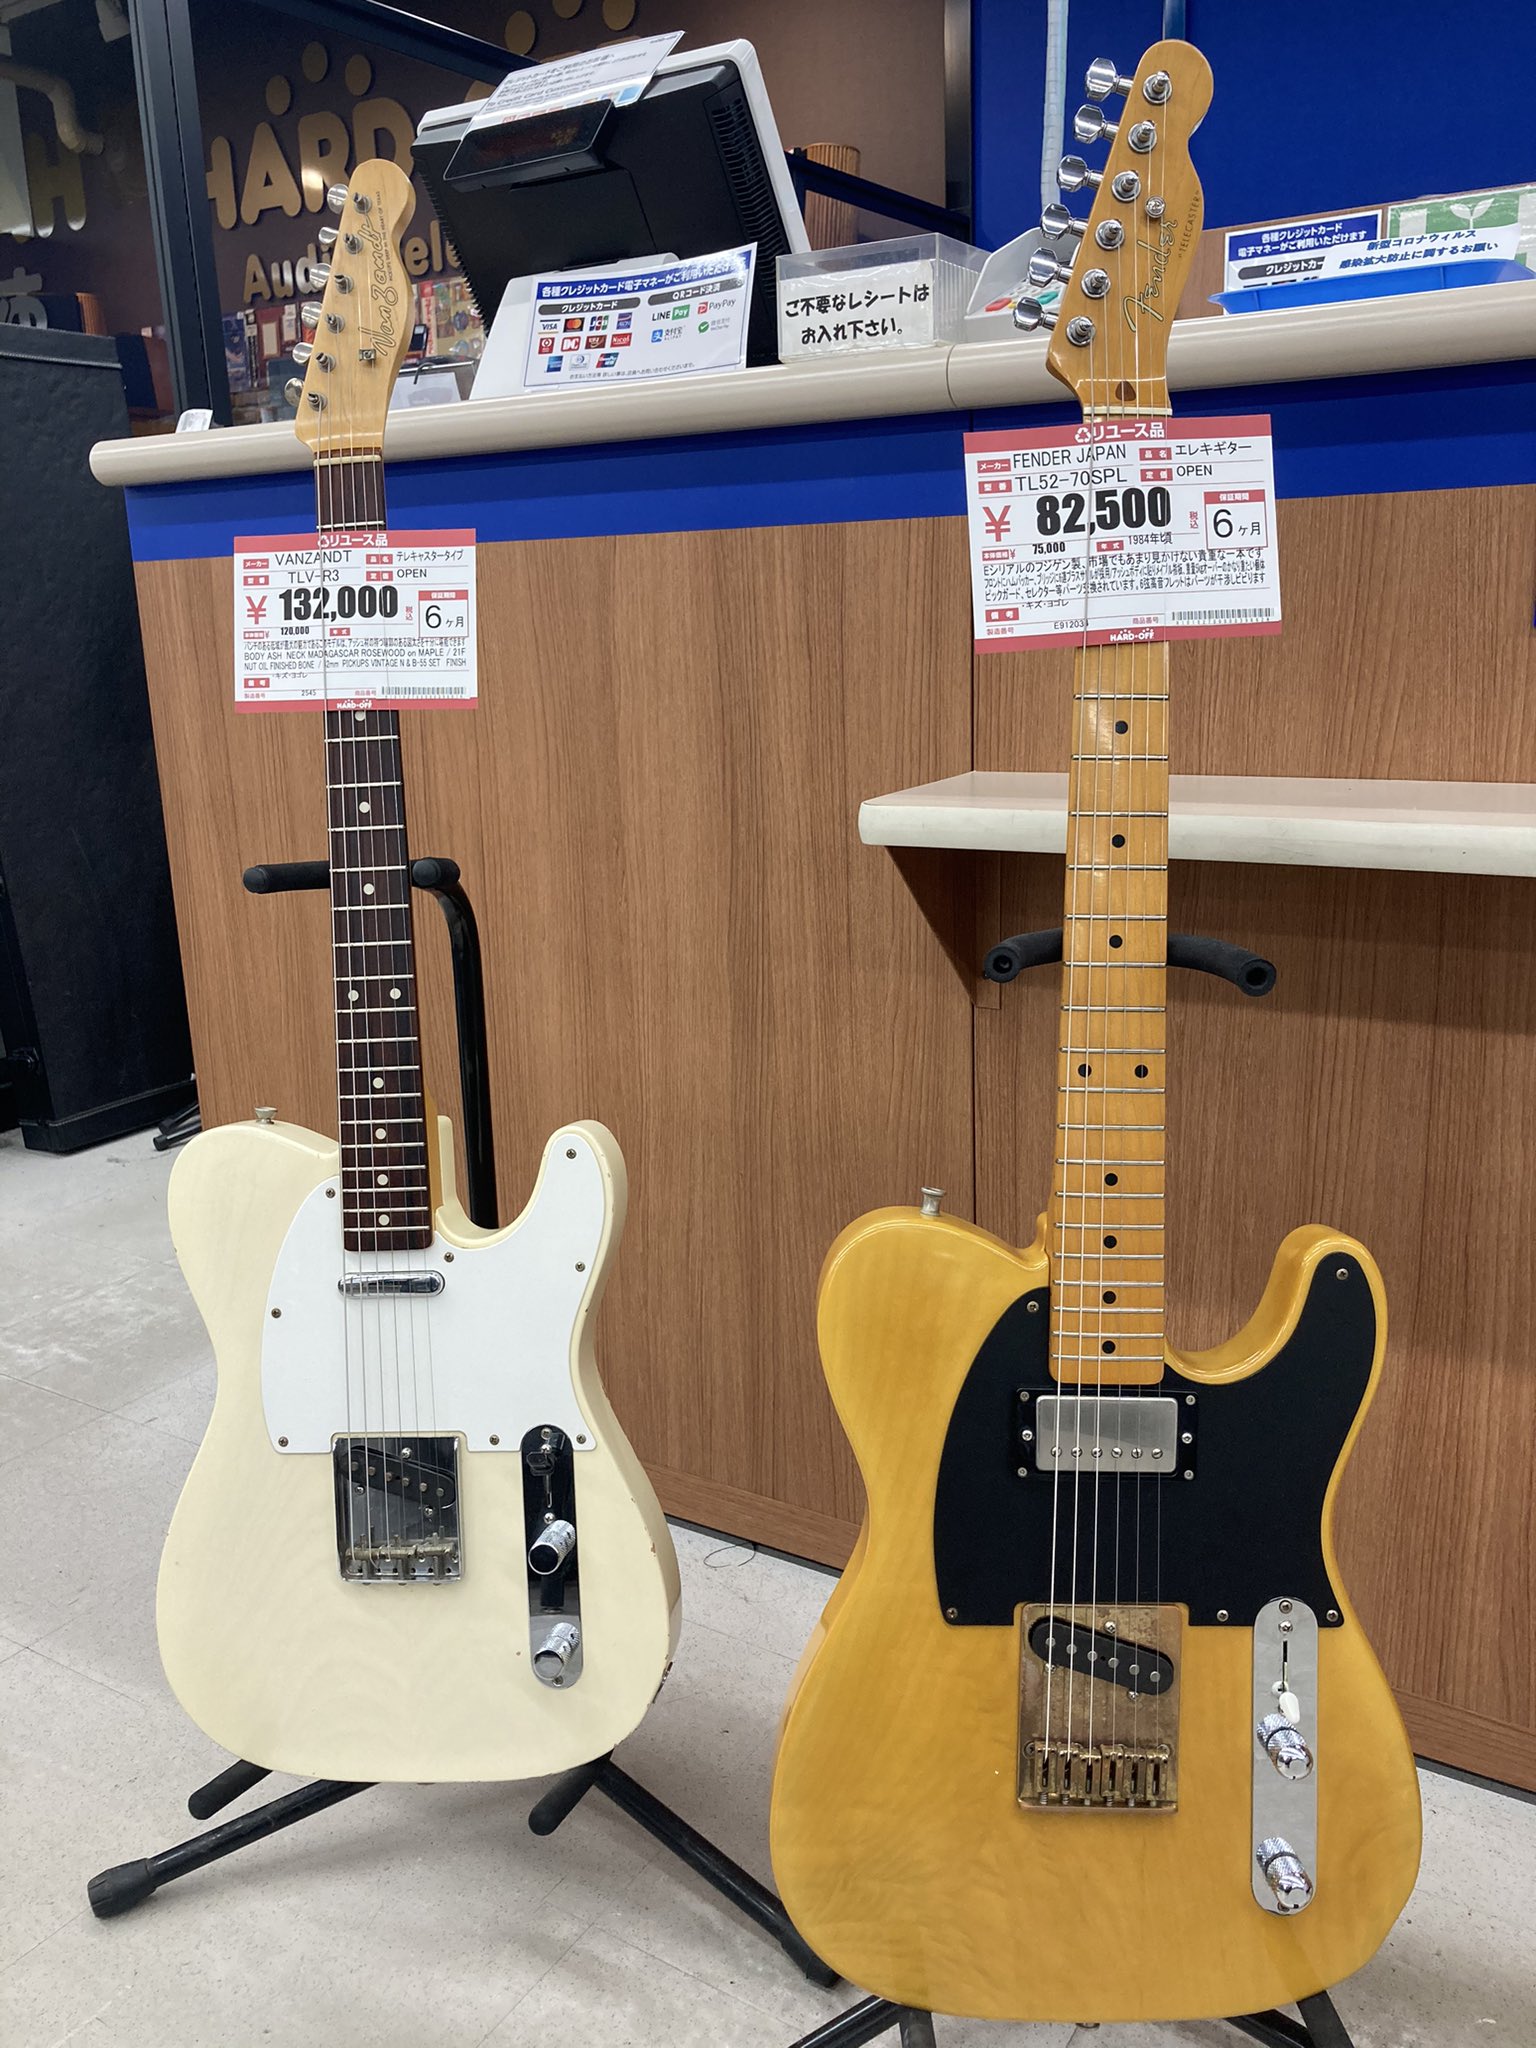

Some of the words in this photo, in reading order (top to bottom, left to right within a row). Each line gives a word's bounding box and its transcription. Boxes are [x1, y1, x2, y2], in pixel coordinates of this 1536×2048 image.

[1367, 230, 1477, 251] 新型コロナウィルス
[1339, 242, 1498, 269] 感染拡大防止に関するお願い
[1122, 219, 1178, 334] Fender
[561, 301, 618, 313] クレジットカード
[709, 299, 736, 310] PayPay
[785, 284, 930, 318] ご不要なレシートは
[652, 311, 671, 321] LINE
[542, 323, 558, 331] VISA
[801, 318, 903, 345] お入れ下さい。
[562, 338, 579, 350] DC
[1094, 422, 1164, 440] リユース品
[1175, 442, 1252, 455] エレキギター
[1013, 449, 1071, 468] FENDER
[1077, 444, 1126, 463] JAPAN
[980, 462, 1008, 470] メーカー
[1176, 465, 1212, 476] OPEN
[1015, 468, 1127, 491] TL52-70SPL
[1036, 486, 1171, 536] 82,500
[330, 533, 388, 547] リユース品
[1128, 531, 1173, 545] 1984年頃
[396, 549, 463, 561] テレキャスタータイプ
[1032, 542, 1065, 555] 75,000
[275, 550, 352, 566] VANZANDT
[288, 569, 340, 584] TLV-R3
[397, 569, 427, 578] OPEN
[279, 585, 398, 622] 132,000
[281, 626, 309, 636] 120,000
[244, 652, 264, 660] BODY
[267, 651, 282, 660] ASH
[286, 651, 306, 659] NECK
[308, 649, 359, 659] MADAGASCAR
[361, 649, 405, 657] ROSEWOOD
[419, 648, 444, 656] MAPLE
[453, 648, 466, 656] 21F
[244, 663, 257, 671] NUT
[258, 662, 268, 670] OIL
[270, 661, 297, 670] FINISHED
[298, 661, 315, 669] BONE
[342, 659, 369, 667] PICKUPS
[371, 659, 398, 667] VINTAGE
[429, 658, 441, 666] SET
[446, 658, 466, 666] FINISH
